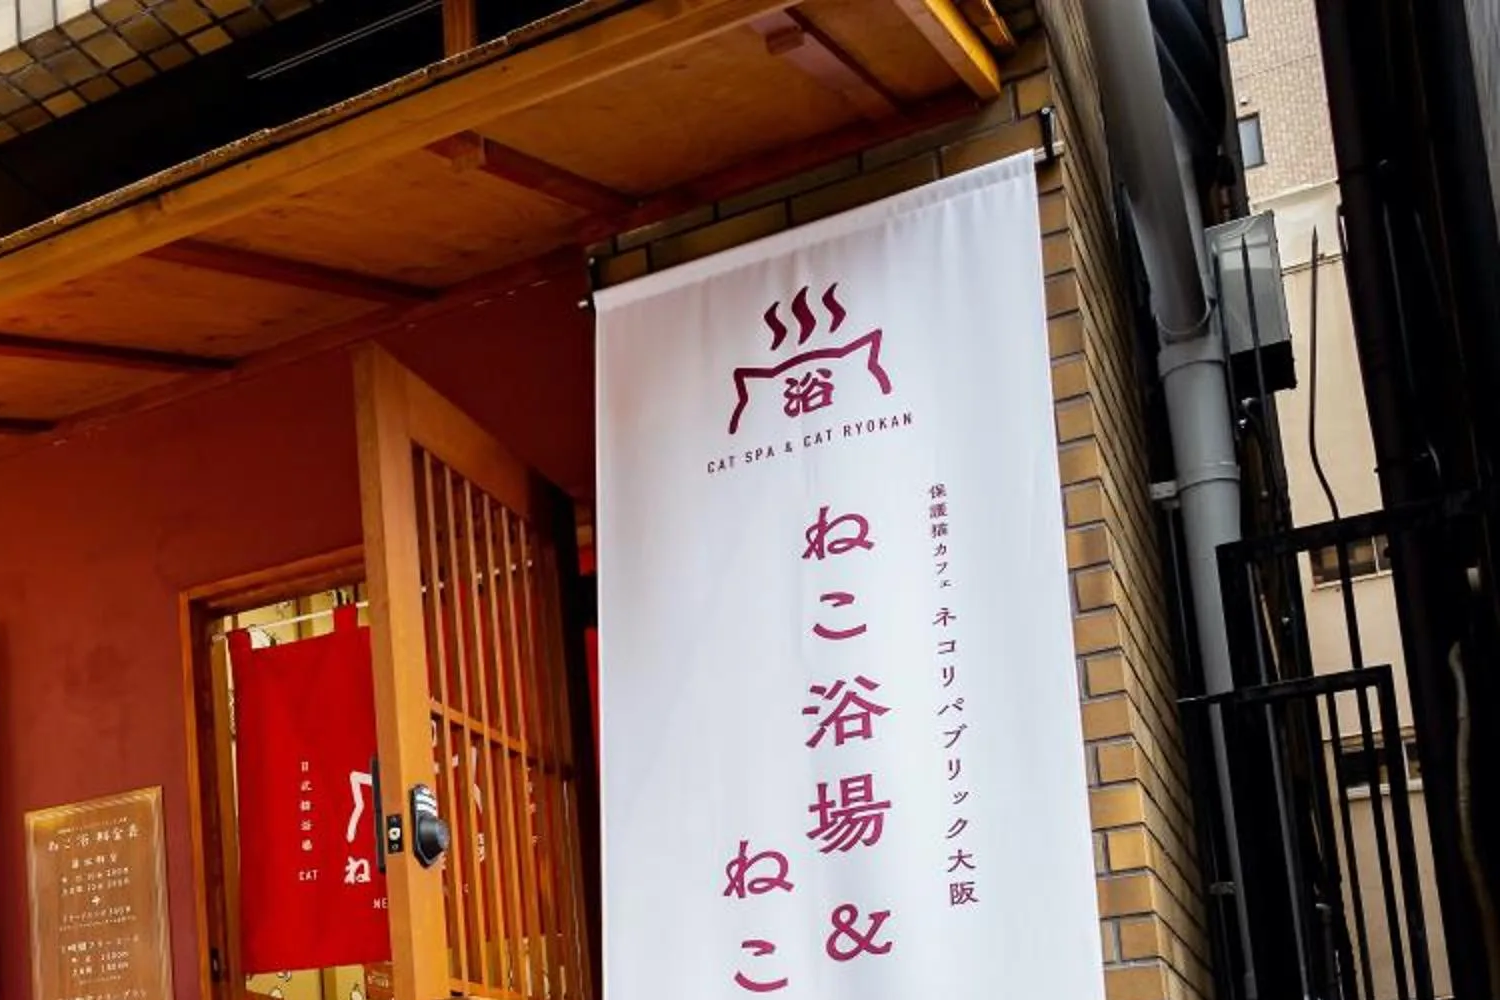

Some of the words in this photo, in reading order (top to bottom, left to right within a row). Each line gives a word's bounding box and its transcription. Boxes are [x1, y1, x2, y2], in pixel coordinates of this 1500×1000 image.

[784, 368, 834, 417] 浴
[706, 455, 736, 475] CAT
[744, 446, 775, 464] SPA
[784, 441, 794, 455] &
[803, 429, 833, 448] CAT
[843, 412, 913, 440] RYOKAN
[933, 607, 979, 906] ネコリパブリック大阪
